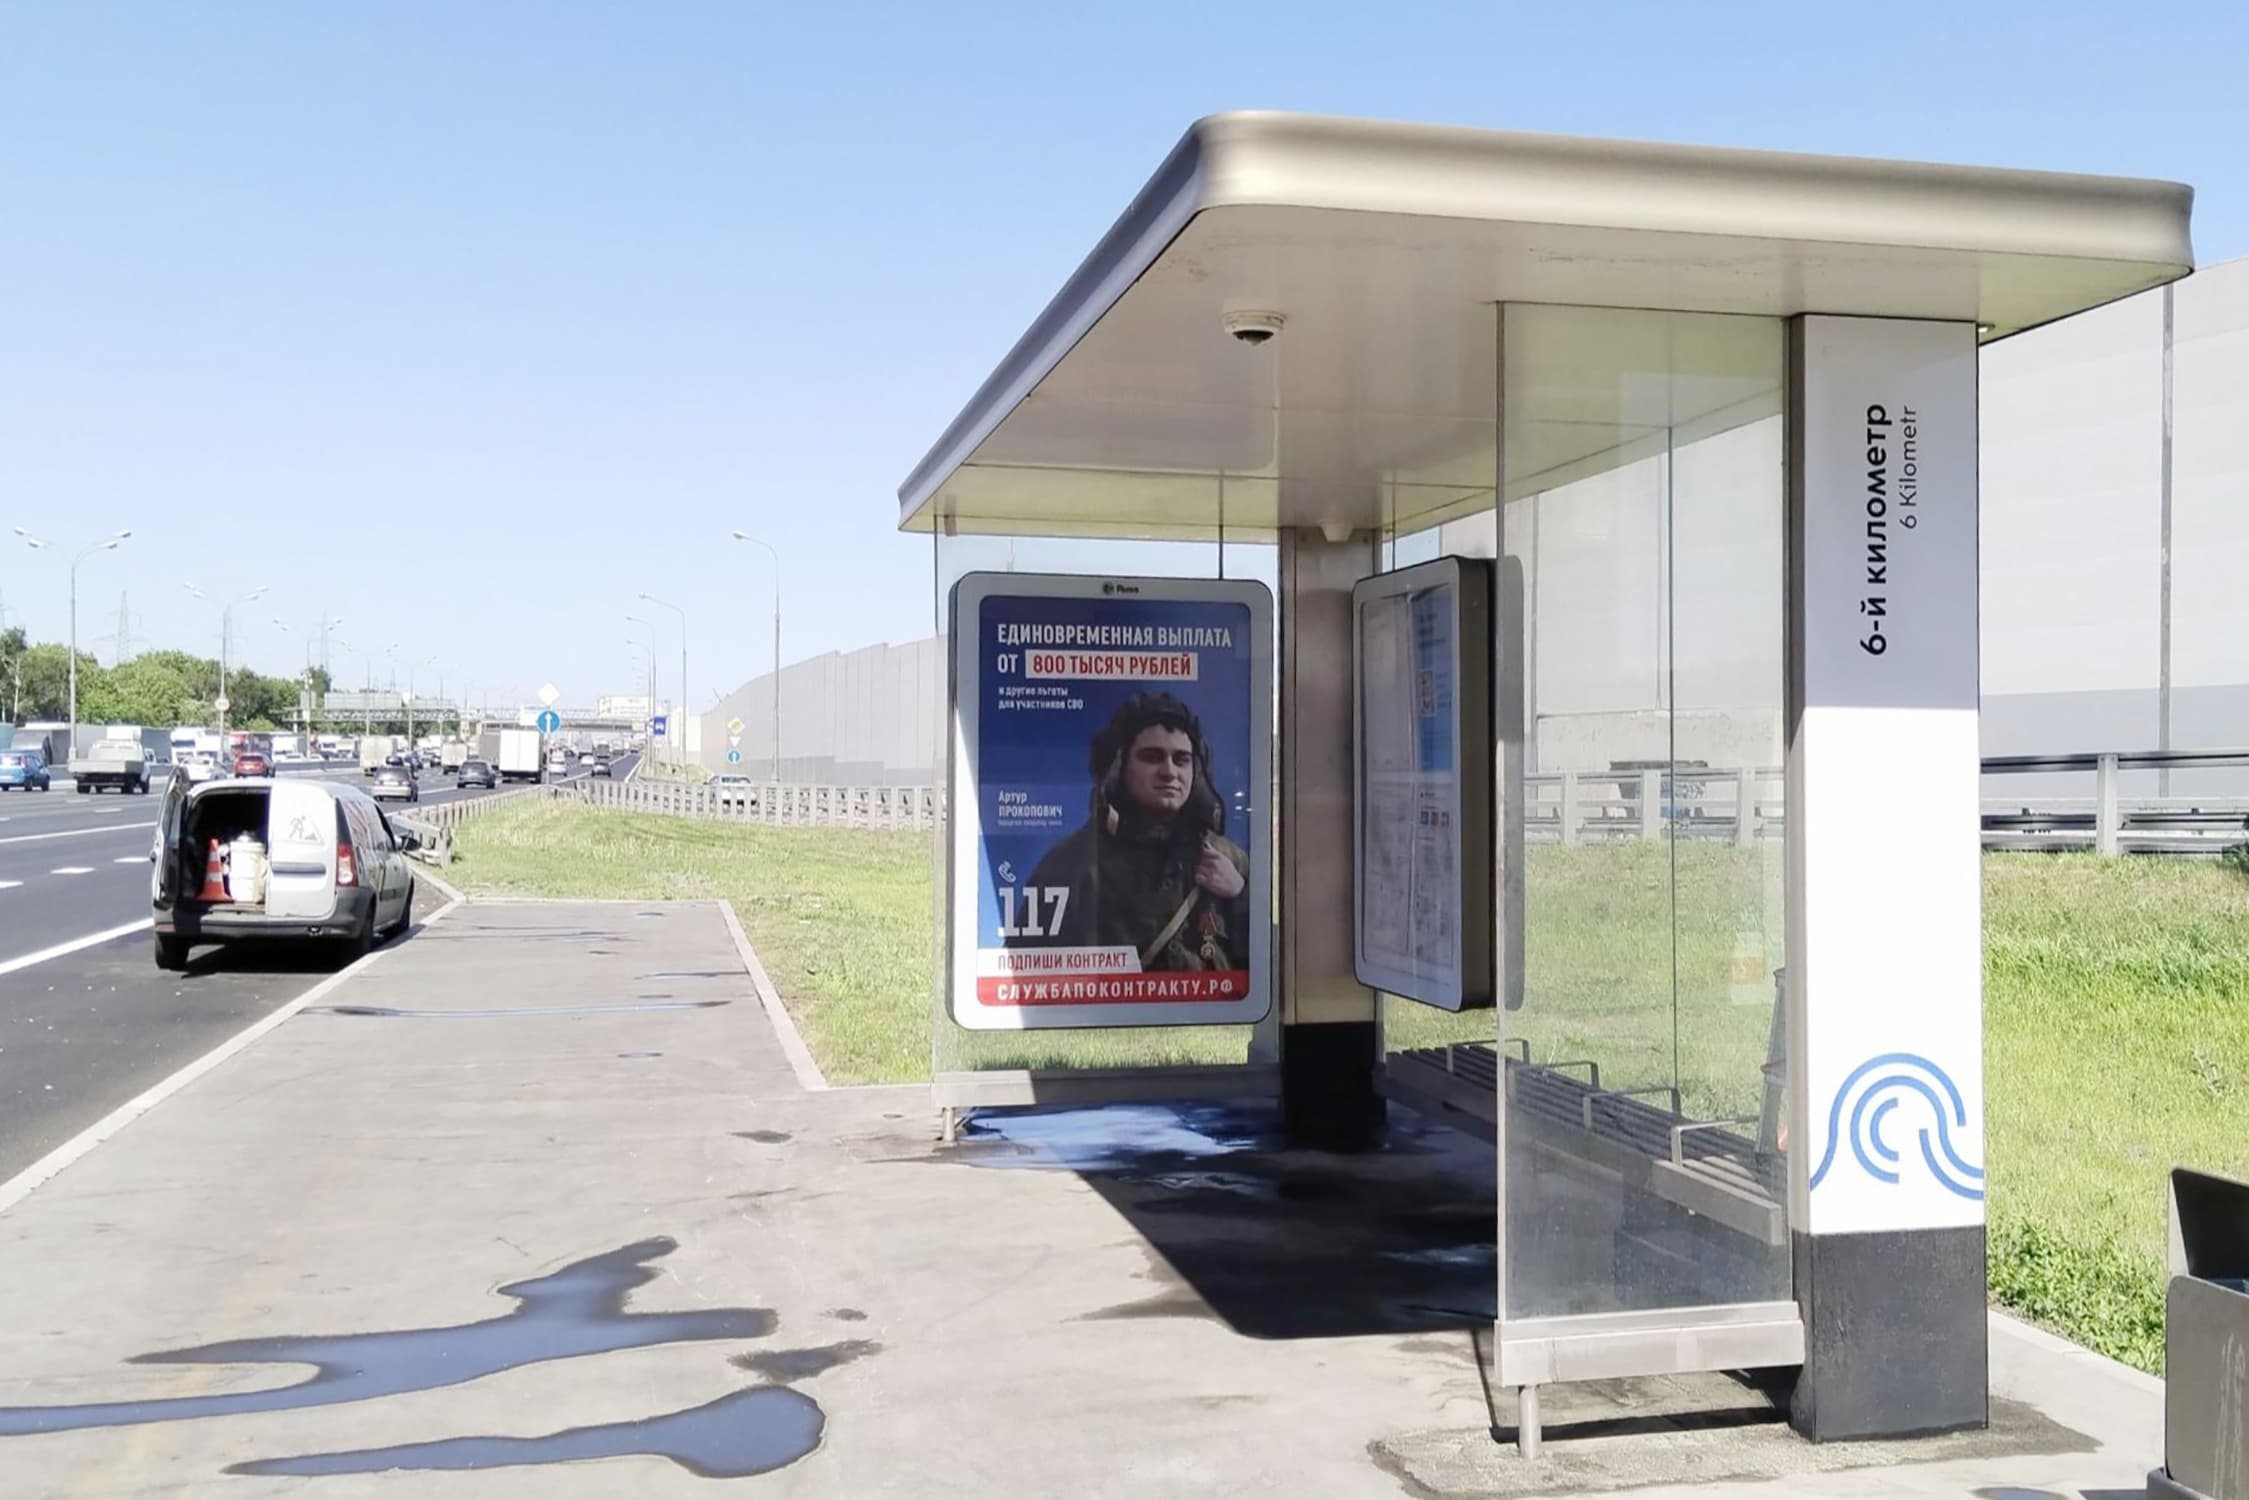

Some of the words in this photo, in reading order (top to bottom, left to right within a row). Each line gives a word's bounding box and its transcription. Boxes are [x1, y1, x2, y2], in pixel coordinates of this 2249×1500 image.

[1899, 406, 1917, 507] Kilometr
[1866, 404, 1892, 584] километр
[1899, 514, 1917, 529] 6
[997, 624, 1153, 646] ЕДИНОВРЕМЕННАЯ
[1157, 628, 1232, 647] ВЫПЛАТА
[1860, 596, 1887, 655] 6-й
[997, 654, 1018, 673] ОТ
[1033, 655, 1065, 673] 800
[1071, 656, 1124, 675] ТЫСЯЧ
[1129, 652, 1191, 675] РУБЛЕЙ
[1006, 687, 1036, 698] другие
[1037, 687, 1068, 696] льготы
[998, 700, 1014, 709] для
[1016, 700, 1065, 710] участников
[1067, 699, 1084, 710] СВО
[998, 790, 1028, 804] Артур
[998, 805, 1063, 817] ПРОКОПОВИЧ
[998, 887, 1070, 936] 117
[998, 955, 1063, 970] ПОДПИШИ
[1066, 952, 1129, 968] КОНТРАКТ
[997, 979, 1234, 1000] СЛУЖБАПОКОНТРАКТУ.РФ
